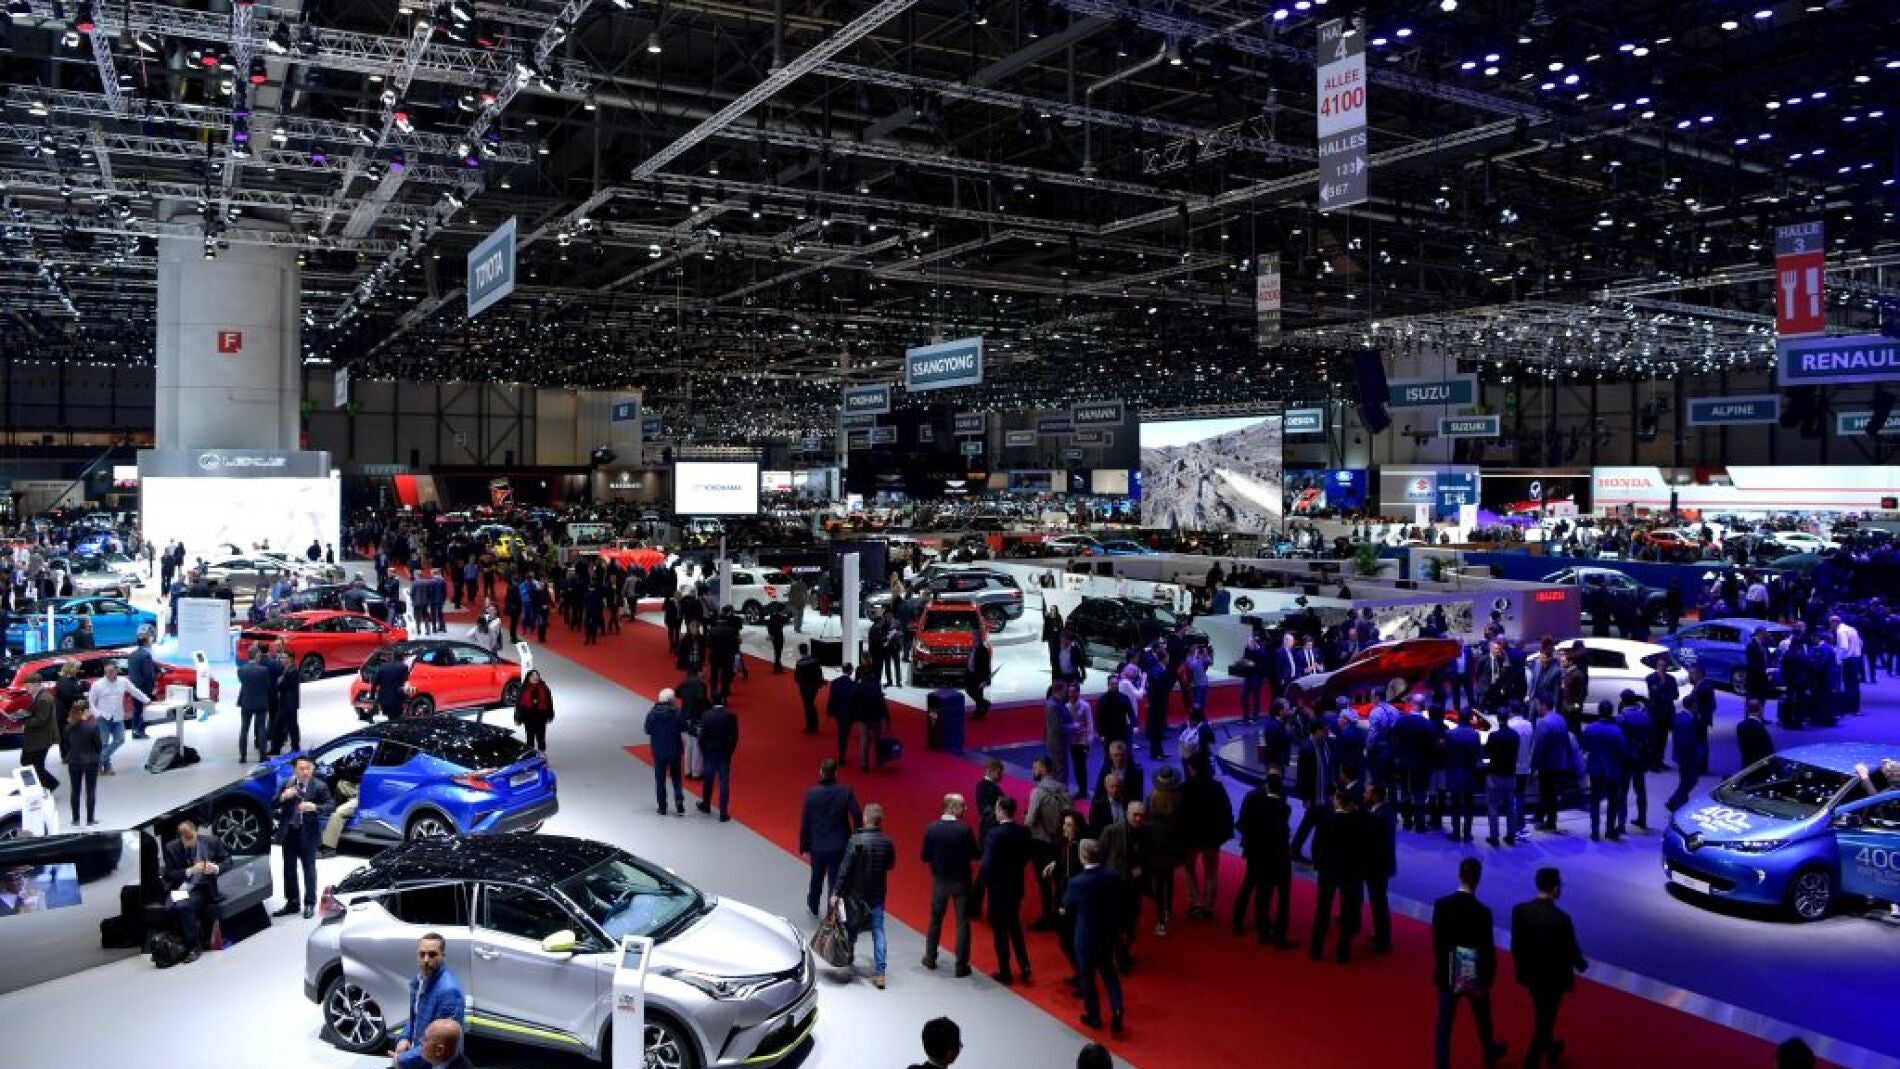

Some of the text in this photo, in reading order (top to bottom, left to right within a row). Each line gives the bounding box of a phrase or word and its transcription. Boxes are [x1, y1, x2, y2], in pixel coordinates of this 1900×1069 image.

[1321, 87, 1364, 117] 4100
[1319, 133, 1366, 157] HALLES
[1778, 223, 1820, 238] HALLE
[1795, 238, 1805, 252] 3
[475, 249, 503, 290] TOYOTA
[224, 333, 237, 348] F
[912, 354, 974, 377] SSANGYONG
[850, 394, 884, 406] YOKOHAMA
[1406, 385, 1450, 401] ISUZU
[1077, 407, 1116, 420] HAMANN
[1712, 404, 1754, 416] ALPINE
[1451, 422, 1486, 432] SUZUKI
[1598, 478, 1653, 488] HONDA
[1535, 591, 1565, 602] ISUZU
